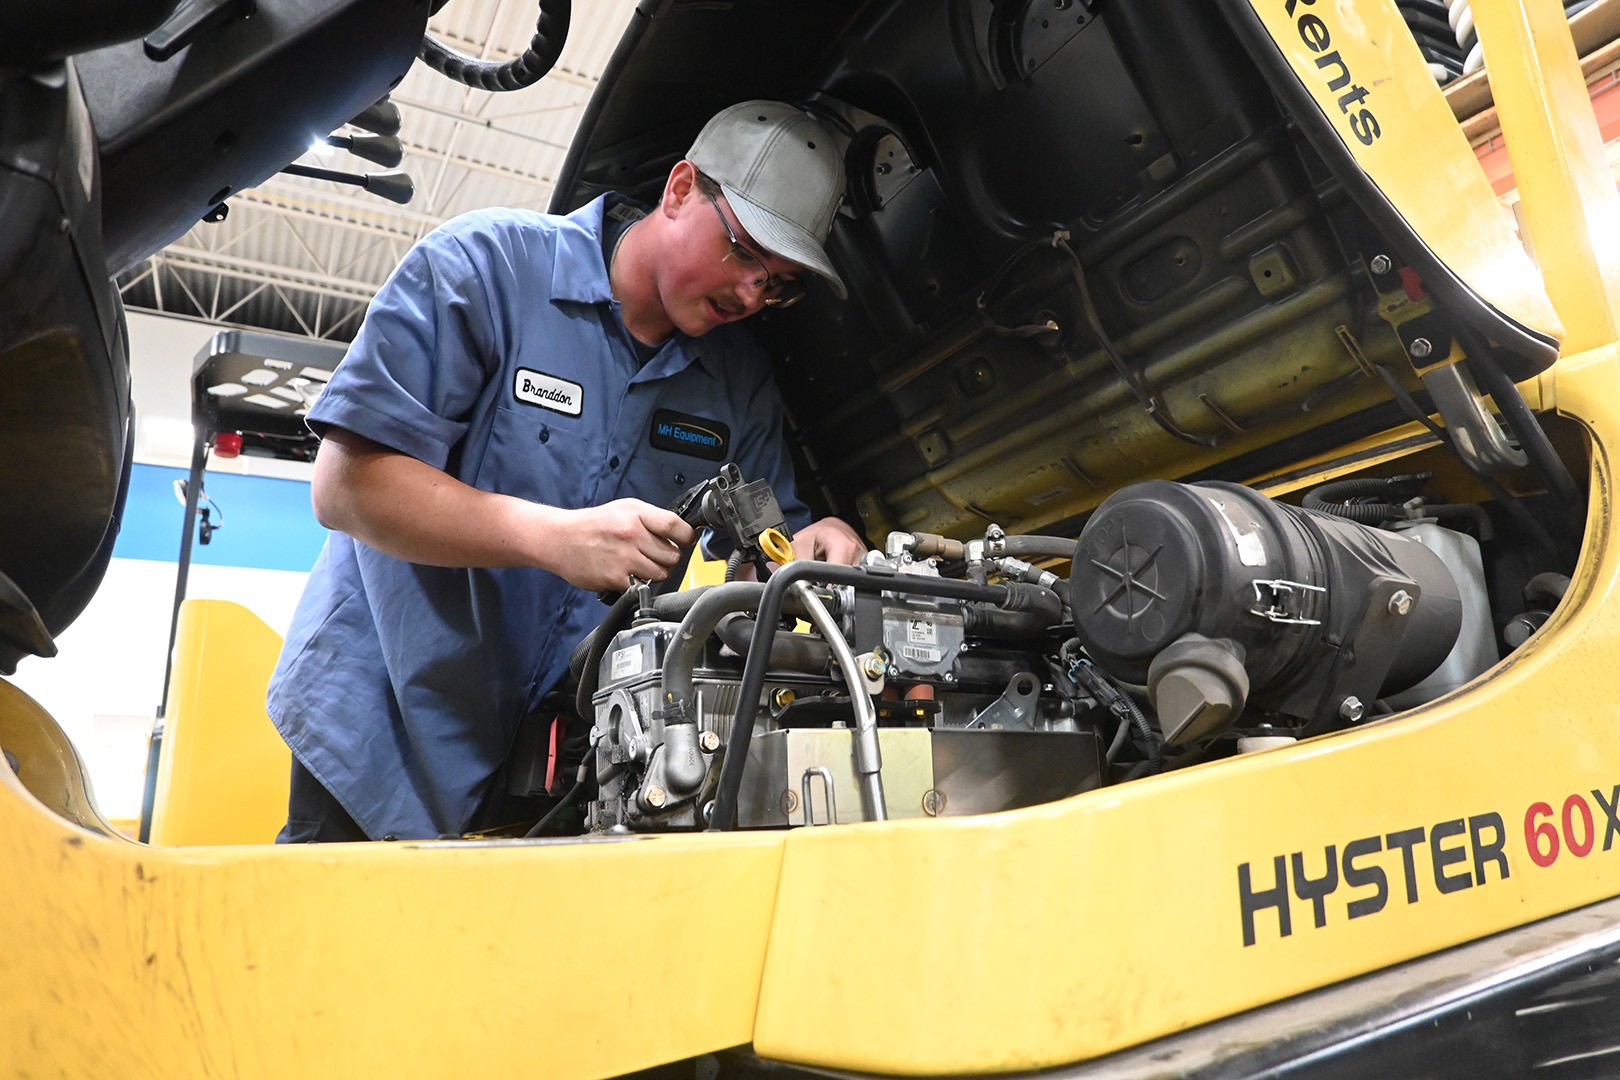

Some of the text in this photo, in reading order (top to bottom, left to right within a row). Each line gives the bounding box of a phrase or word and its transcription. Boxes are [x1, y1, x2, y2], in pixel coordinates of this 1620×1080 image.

[522, 378, 573, 406] Branddon
[657, 423, 717, 447] MH Equipment
[1237, 811, 1510, 947] HYSTER
